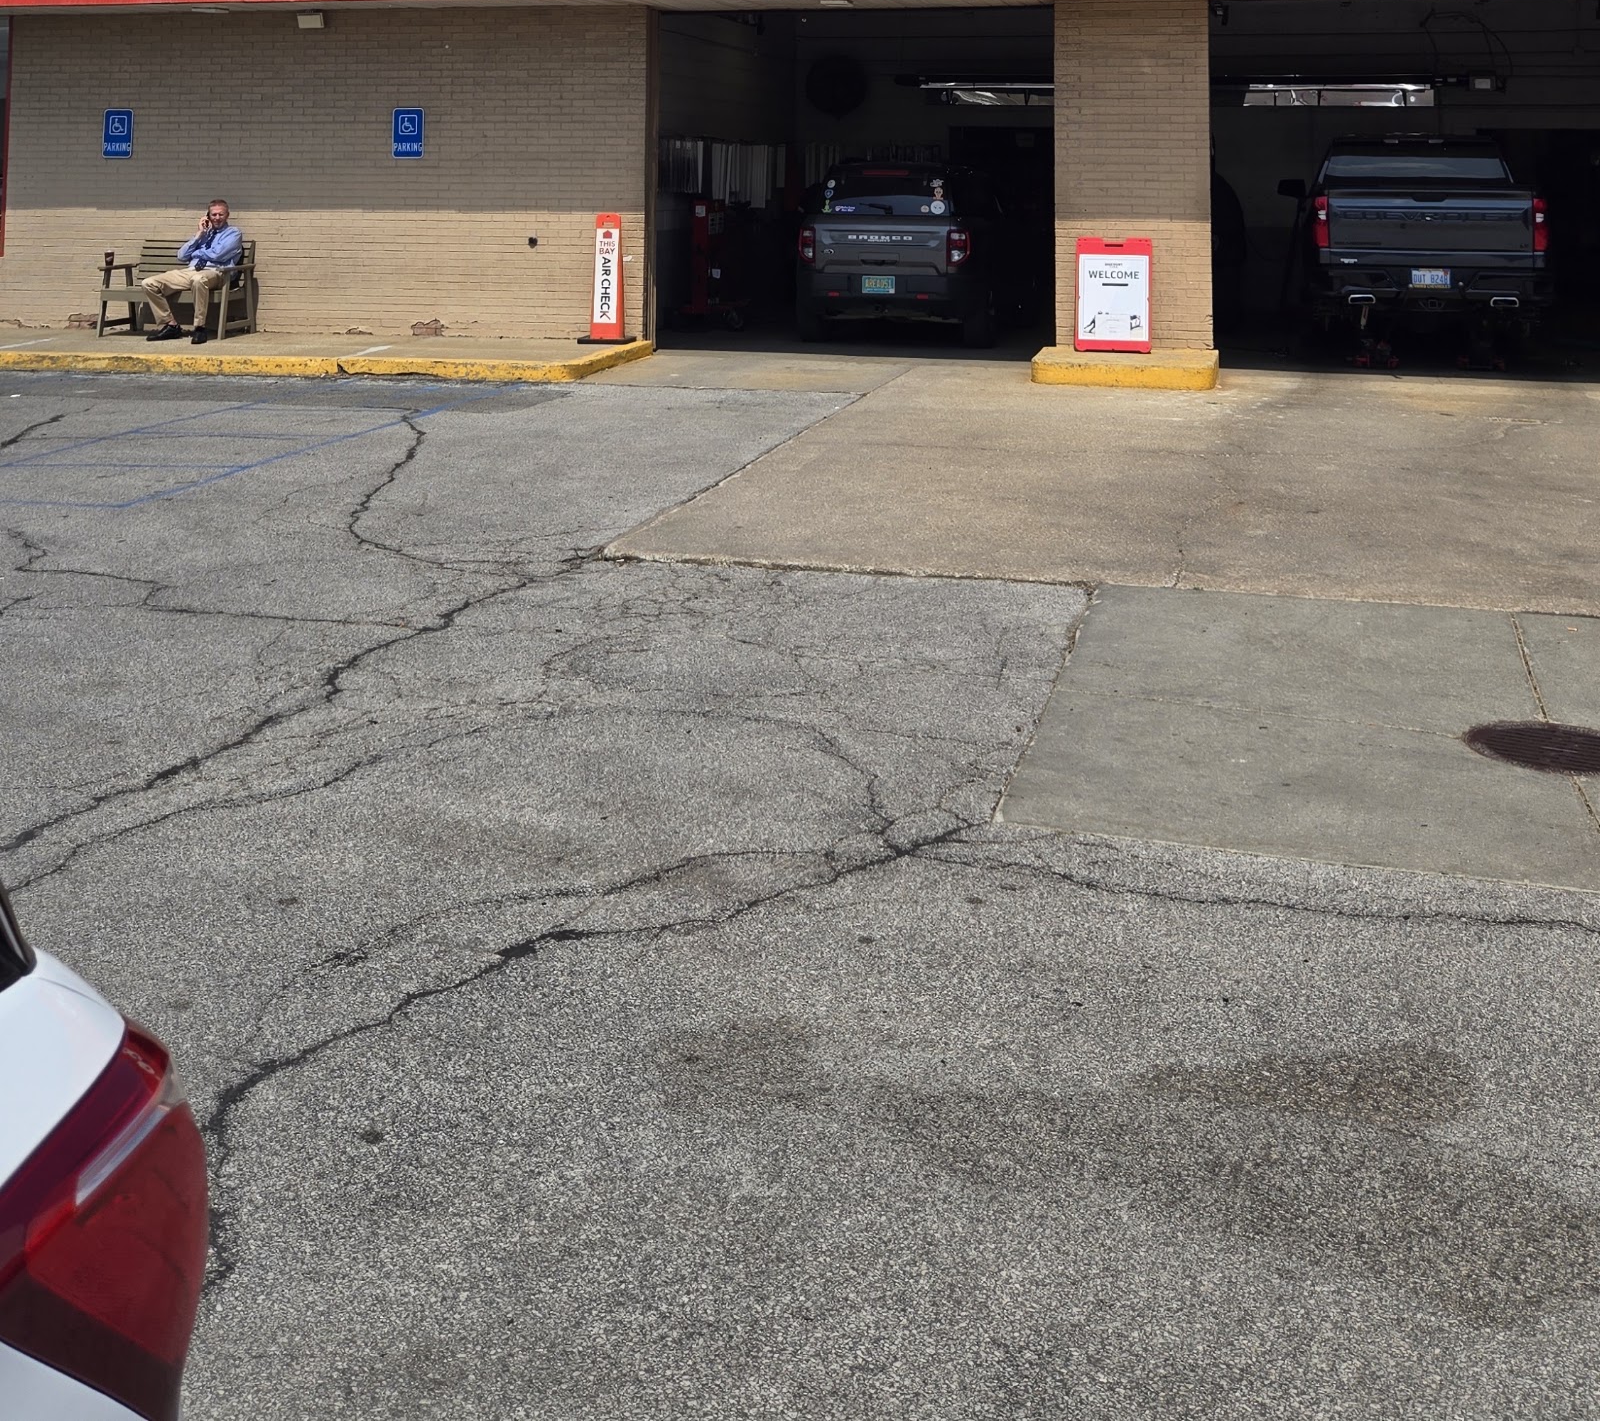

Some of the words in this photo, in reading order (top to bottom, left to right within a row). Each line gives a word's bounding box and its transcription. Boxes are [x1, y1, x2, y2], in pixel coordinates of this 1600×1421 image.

[104, 142, 131, 151] PARKING
[394, 142, 423, 151] PARKING
[601, 256, 611, 276] AIR
[1088, 270, 1140, 280] WELCOME
[600, 278, 611, 320] CHECK
